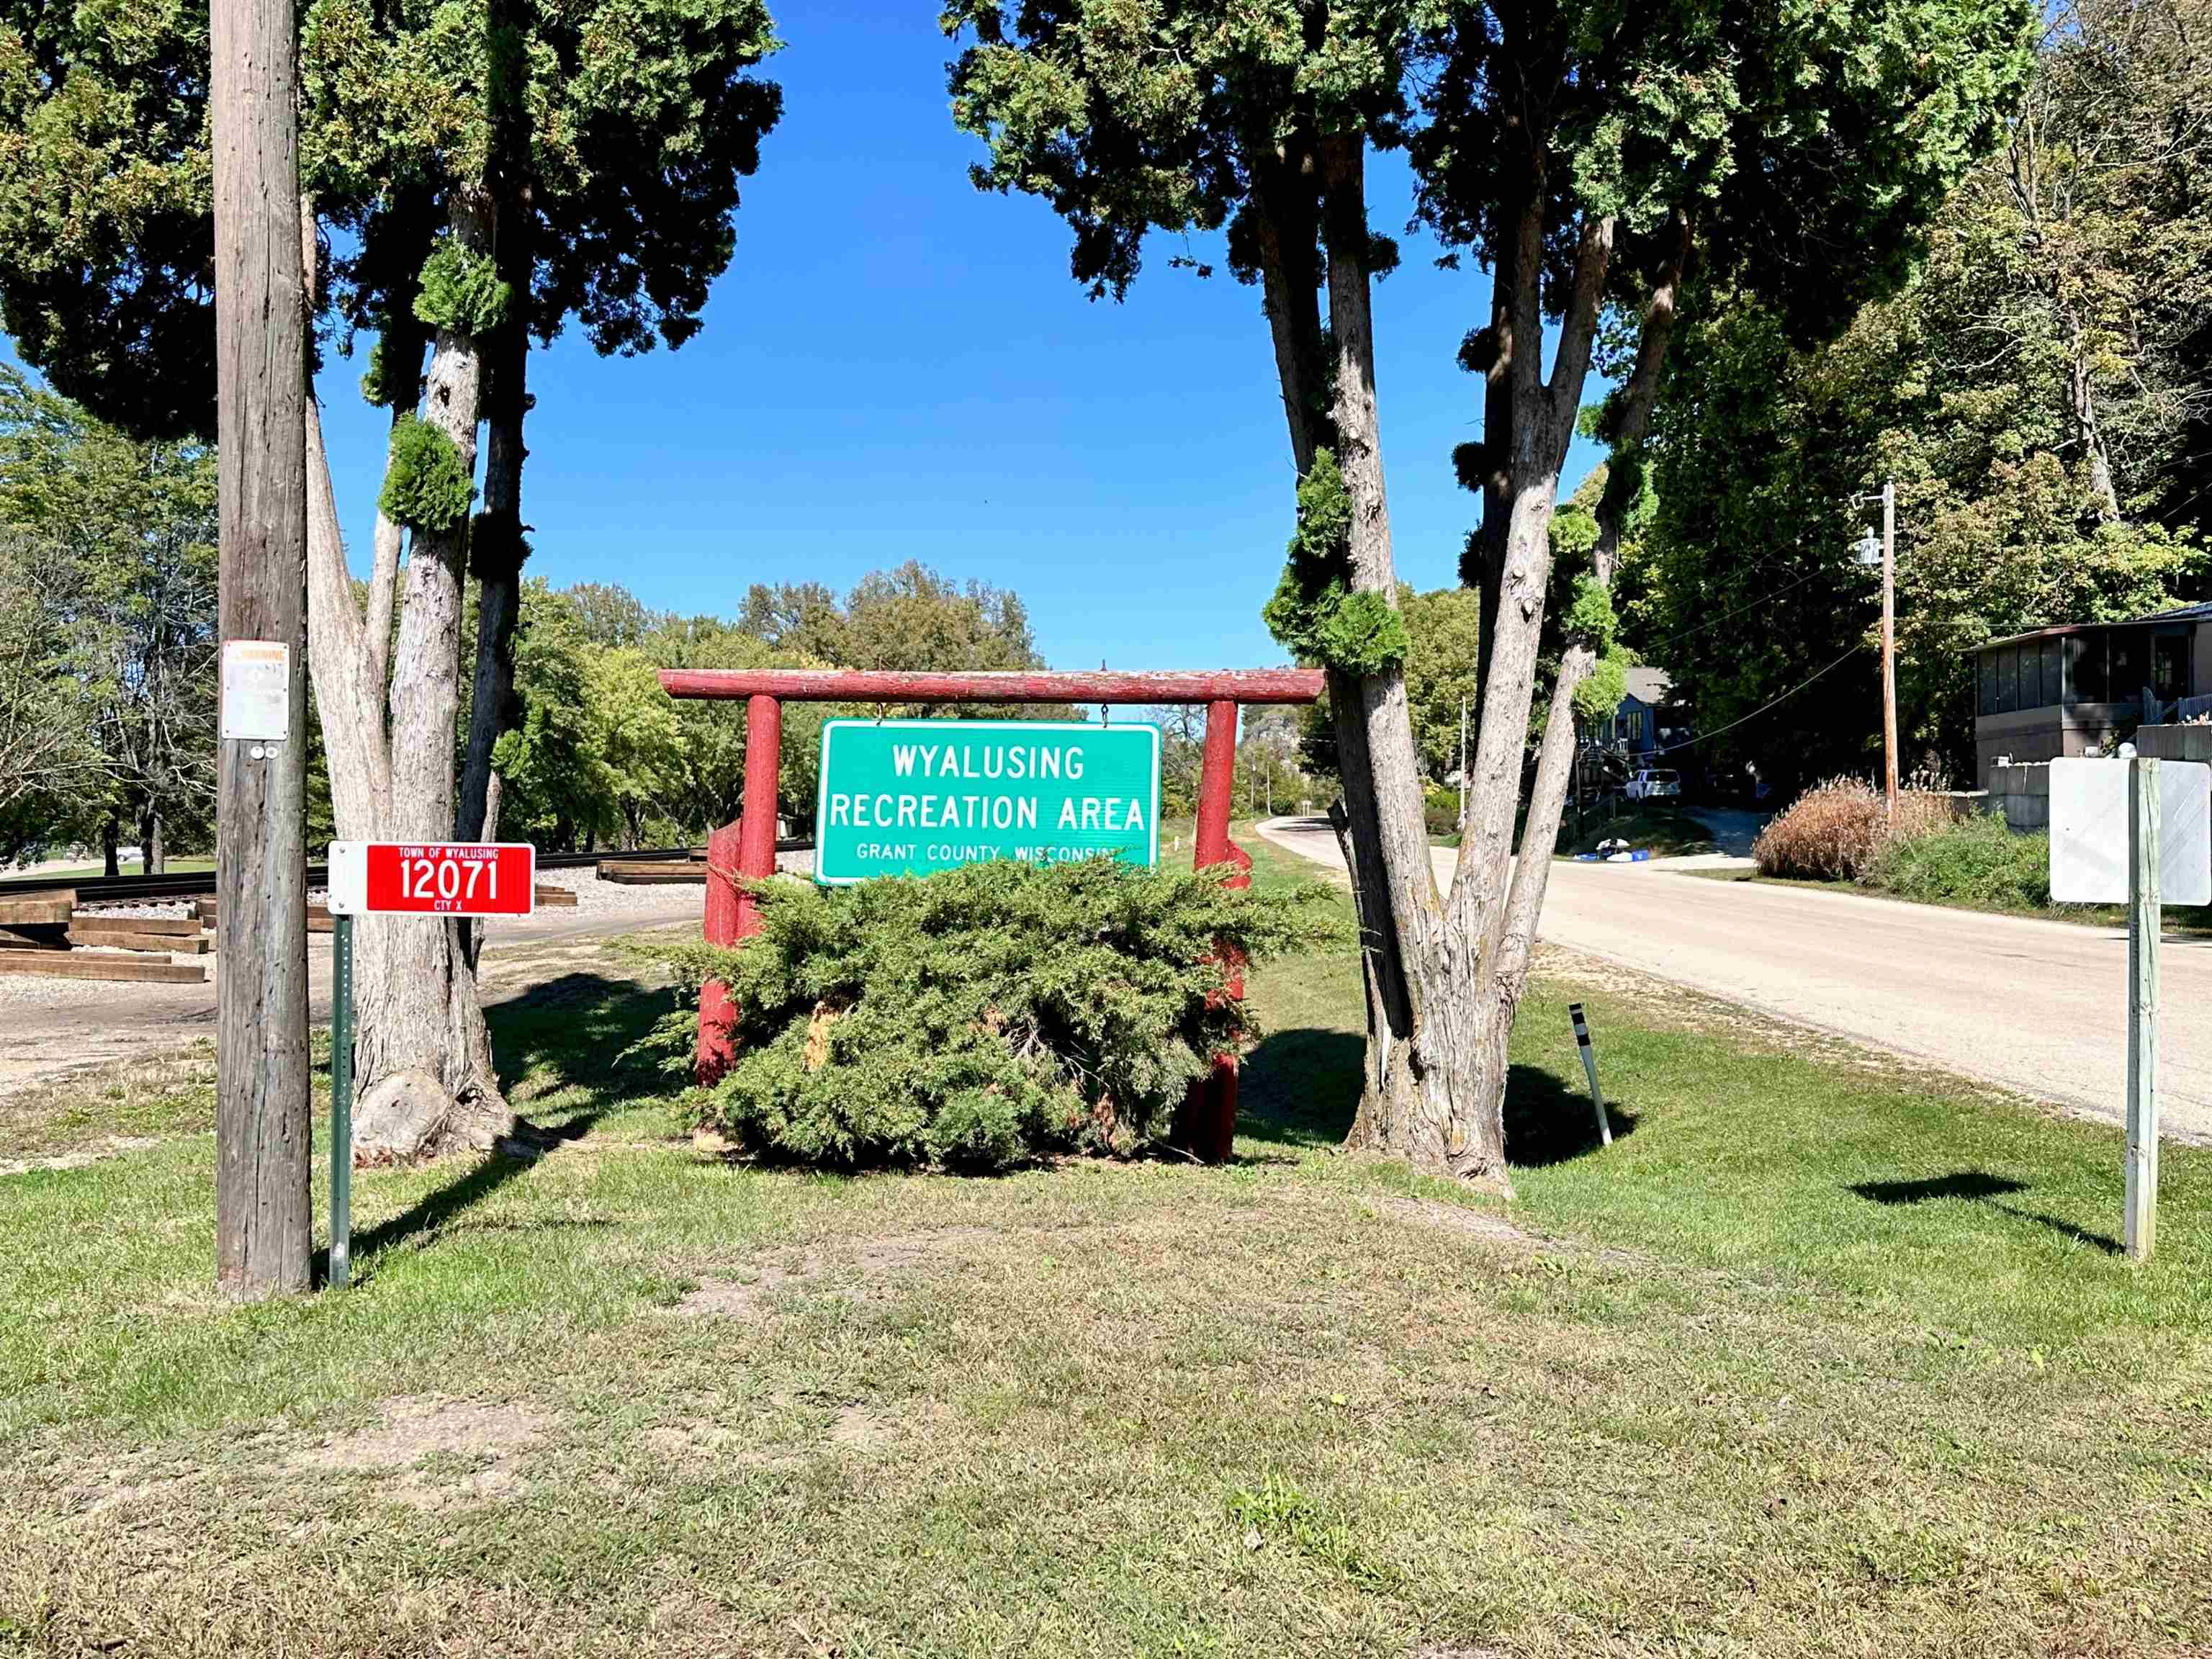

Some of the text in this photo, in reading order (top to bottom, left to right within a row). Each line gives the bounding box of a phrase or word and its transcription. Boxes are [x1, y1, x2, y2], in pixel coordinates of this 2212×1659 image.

[892, 745, 1084, 779] WYALUSING
[830, 794, 1145, 830] RECREATION AREA
[399, 847, 499, 858] TOWN OF WYALUSING
[856, 844, 915, 860] GRANT
[927, 845, 1000, 862] COUNTY
[401, 860, 498, 899] 12071
[434, 900, 462, 911] CTY X
